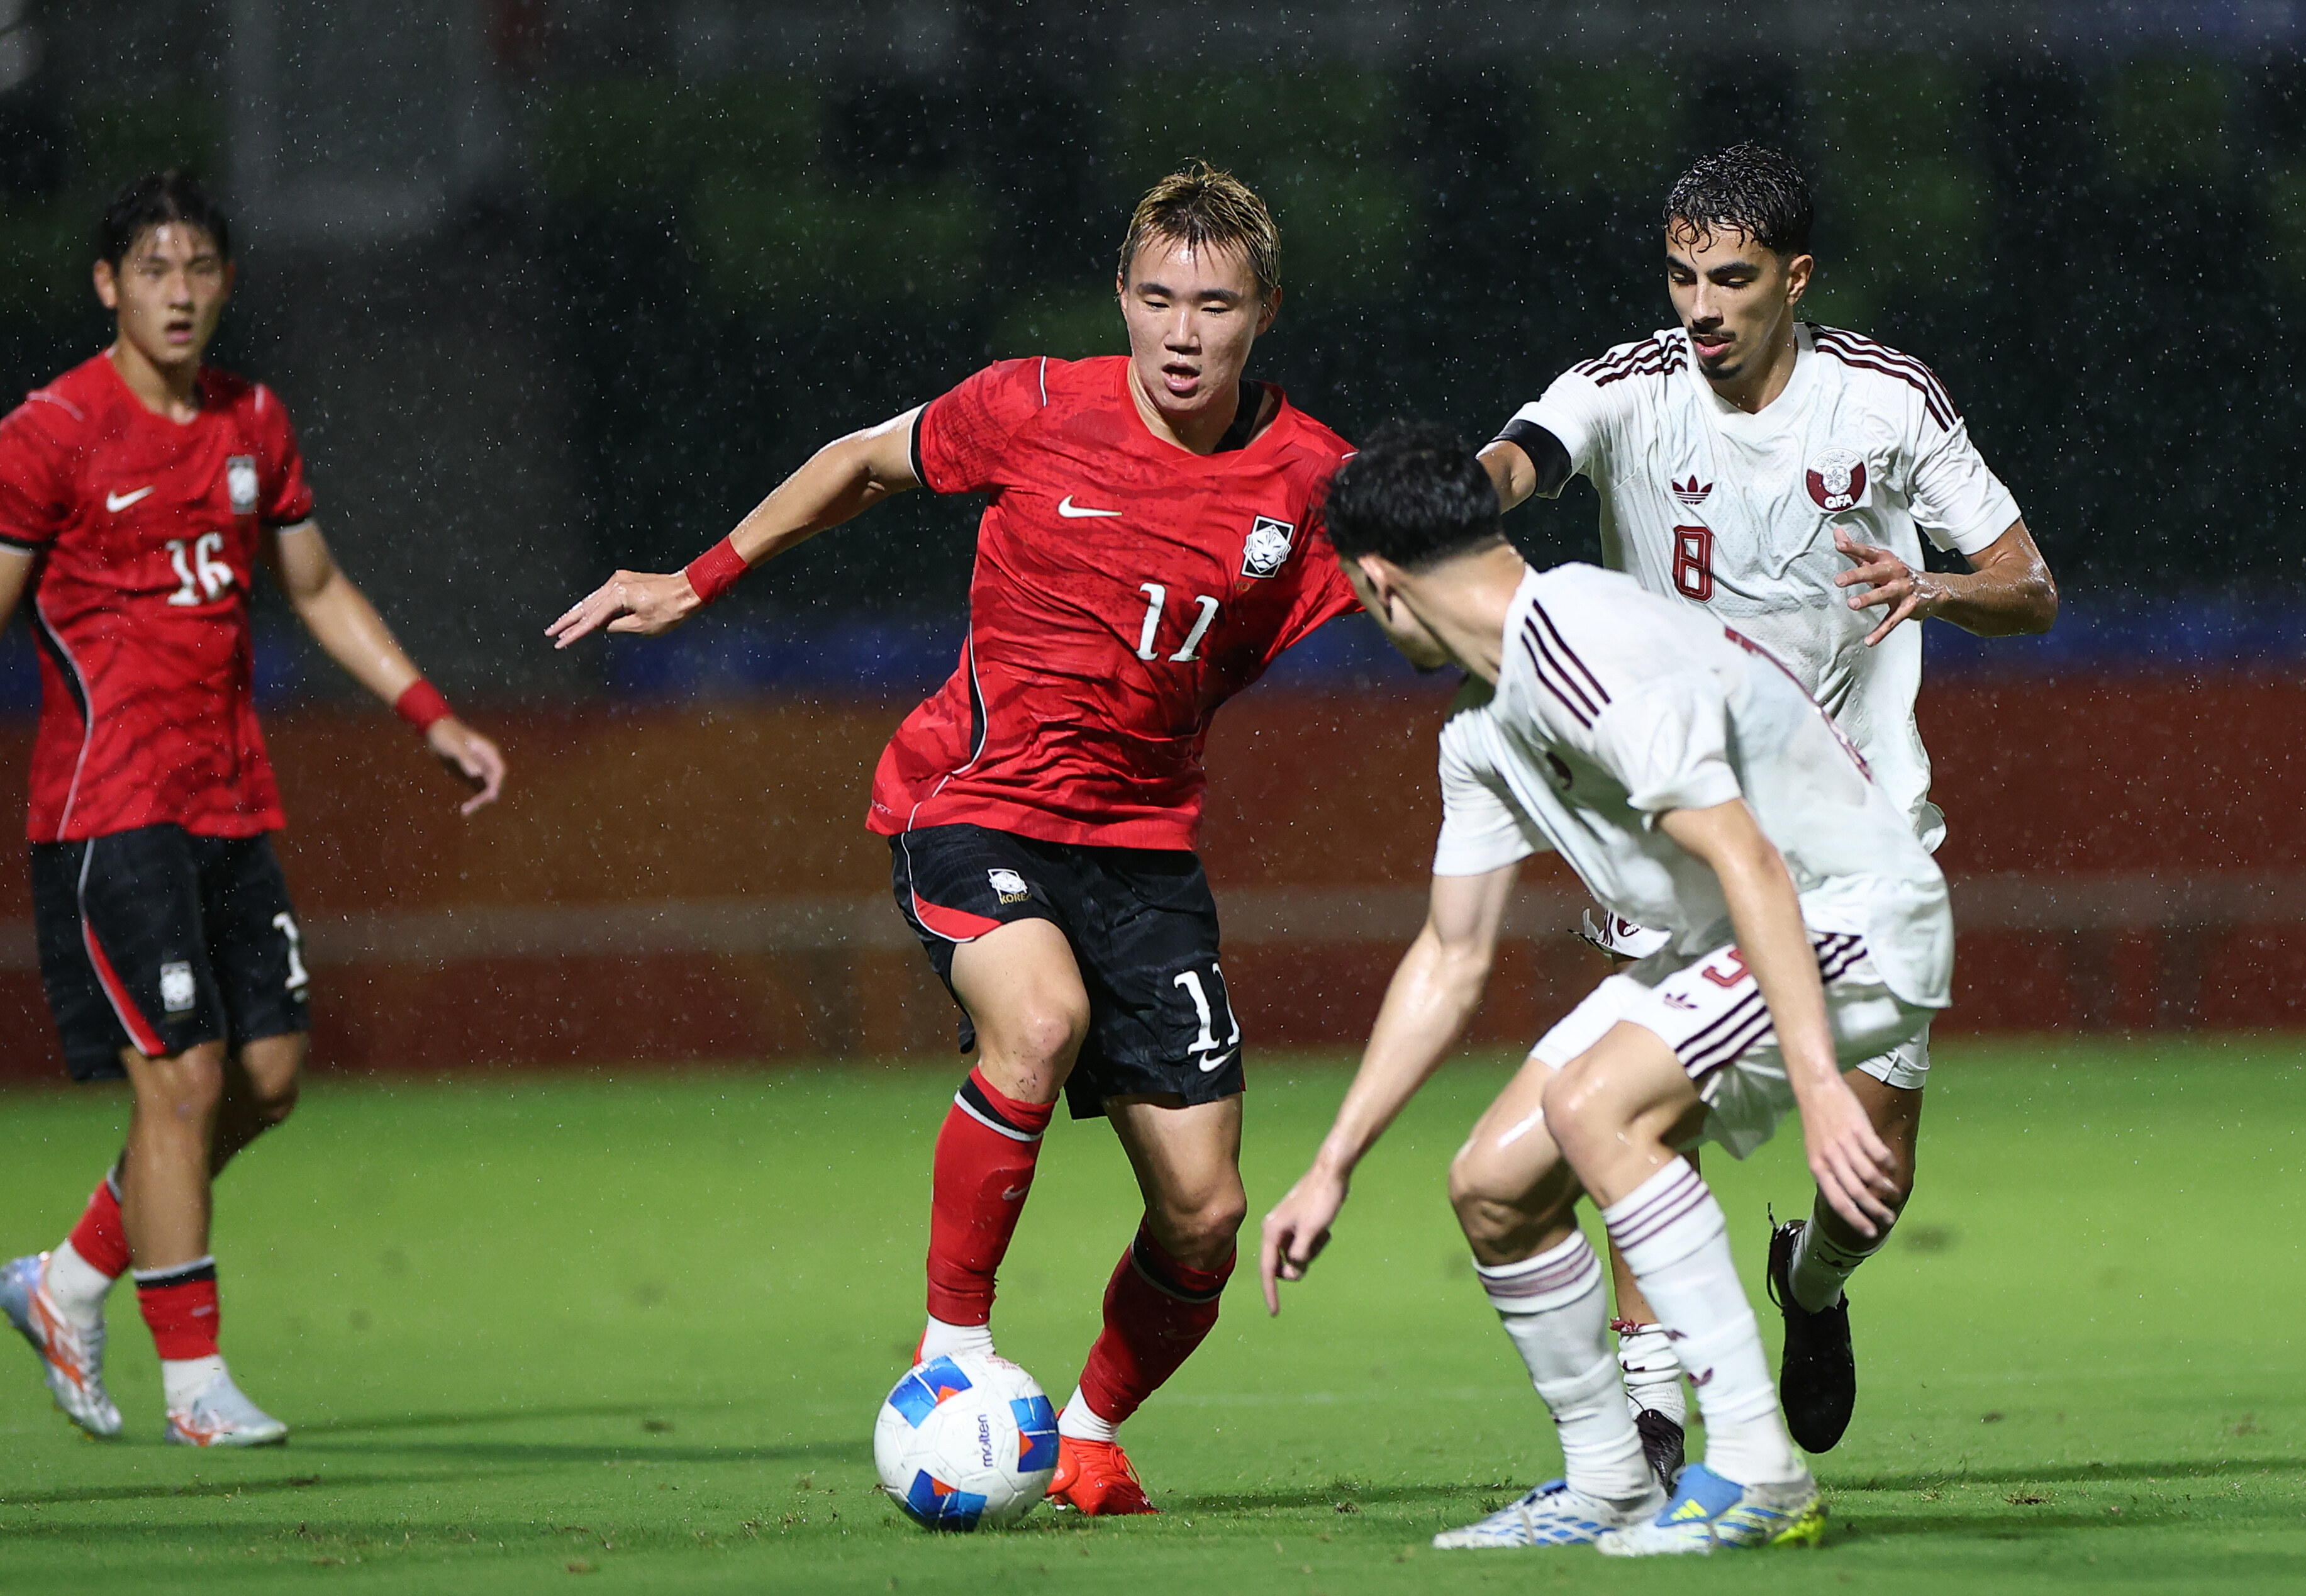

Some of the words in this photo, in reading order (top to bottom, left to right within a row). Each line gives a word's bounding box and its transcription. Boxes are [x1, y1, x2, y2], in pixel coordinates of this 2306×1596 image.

[1824, 494, 1854, 509] QFA
[165, 532, 234, 605] 16
[1673, 525, 1715, 603] 8
[1136, 582, 1219, 662] 11
[1174, 962, 1240, 1056] 11
[978, 1414, 993, 1467] molten
